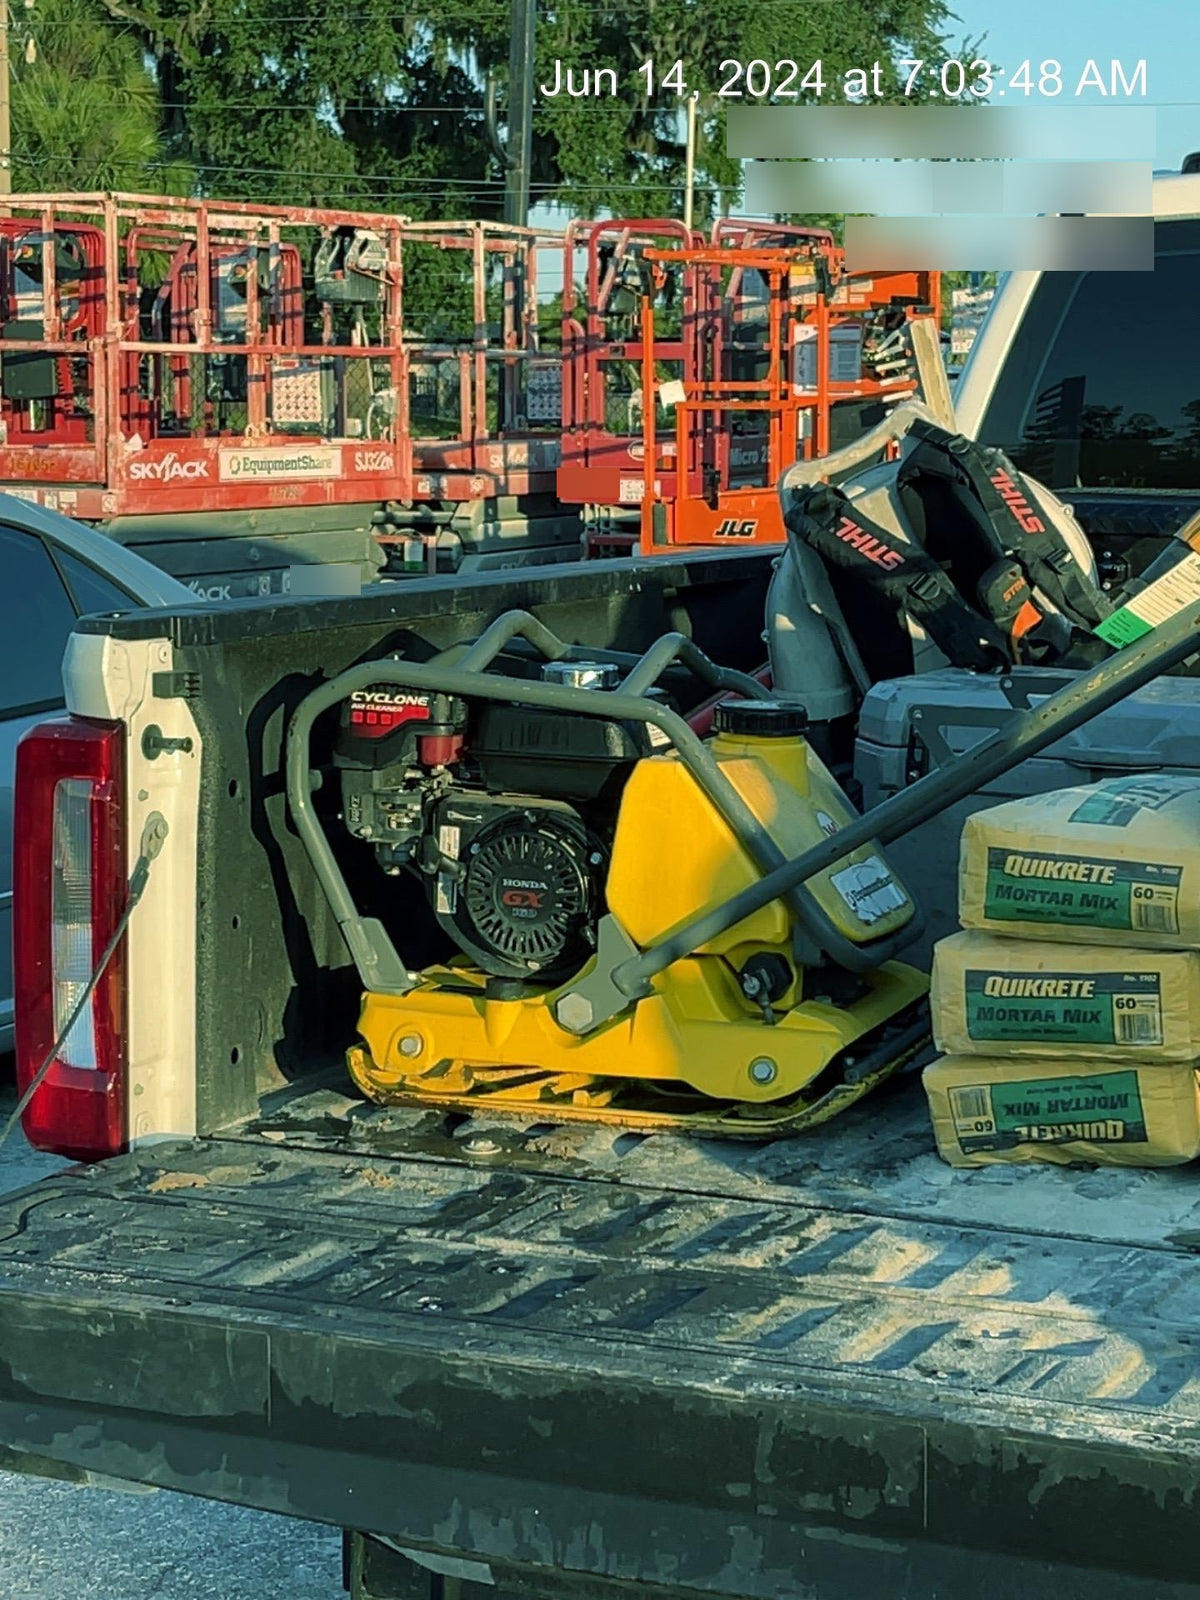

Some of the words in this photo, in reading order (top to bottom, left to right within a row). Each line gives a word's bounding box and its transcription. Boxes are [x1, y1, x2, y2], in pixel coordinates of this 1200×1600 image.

[129, 452, 209, 482] SKYJACK
[242, 455, 333, 475] EquipmentShare
[989, 467, 1047, 534] STIHL
[714, 519, 757, 538] JLG
[834, 516, 906, 571] STIHL
[351, 691, 430, 706] CYCLONE
[1003, 855, 1117, 884] QUIKRETE
[503, 879, 549, 890] HONDA
[1133, 887, 1154, 900] 60
[502, 890, 545, 908] GX
[995, 884, 1074, 907] MORTAR
[1079, 893, 1120, 911] MIX
[984, 976, 1096, 998] QUIKRETE
[1115, 998, 1136, 1010] 60
[976, 1006, 1056, 1023] MORTAR
[1063, 1009, 1102, 1024] MIX
[974, 1119, 994, 1132] 60
